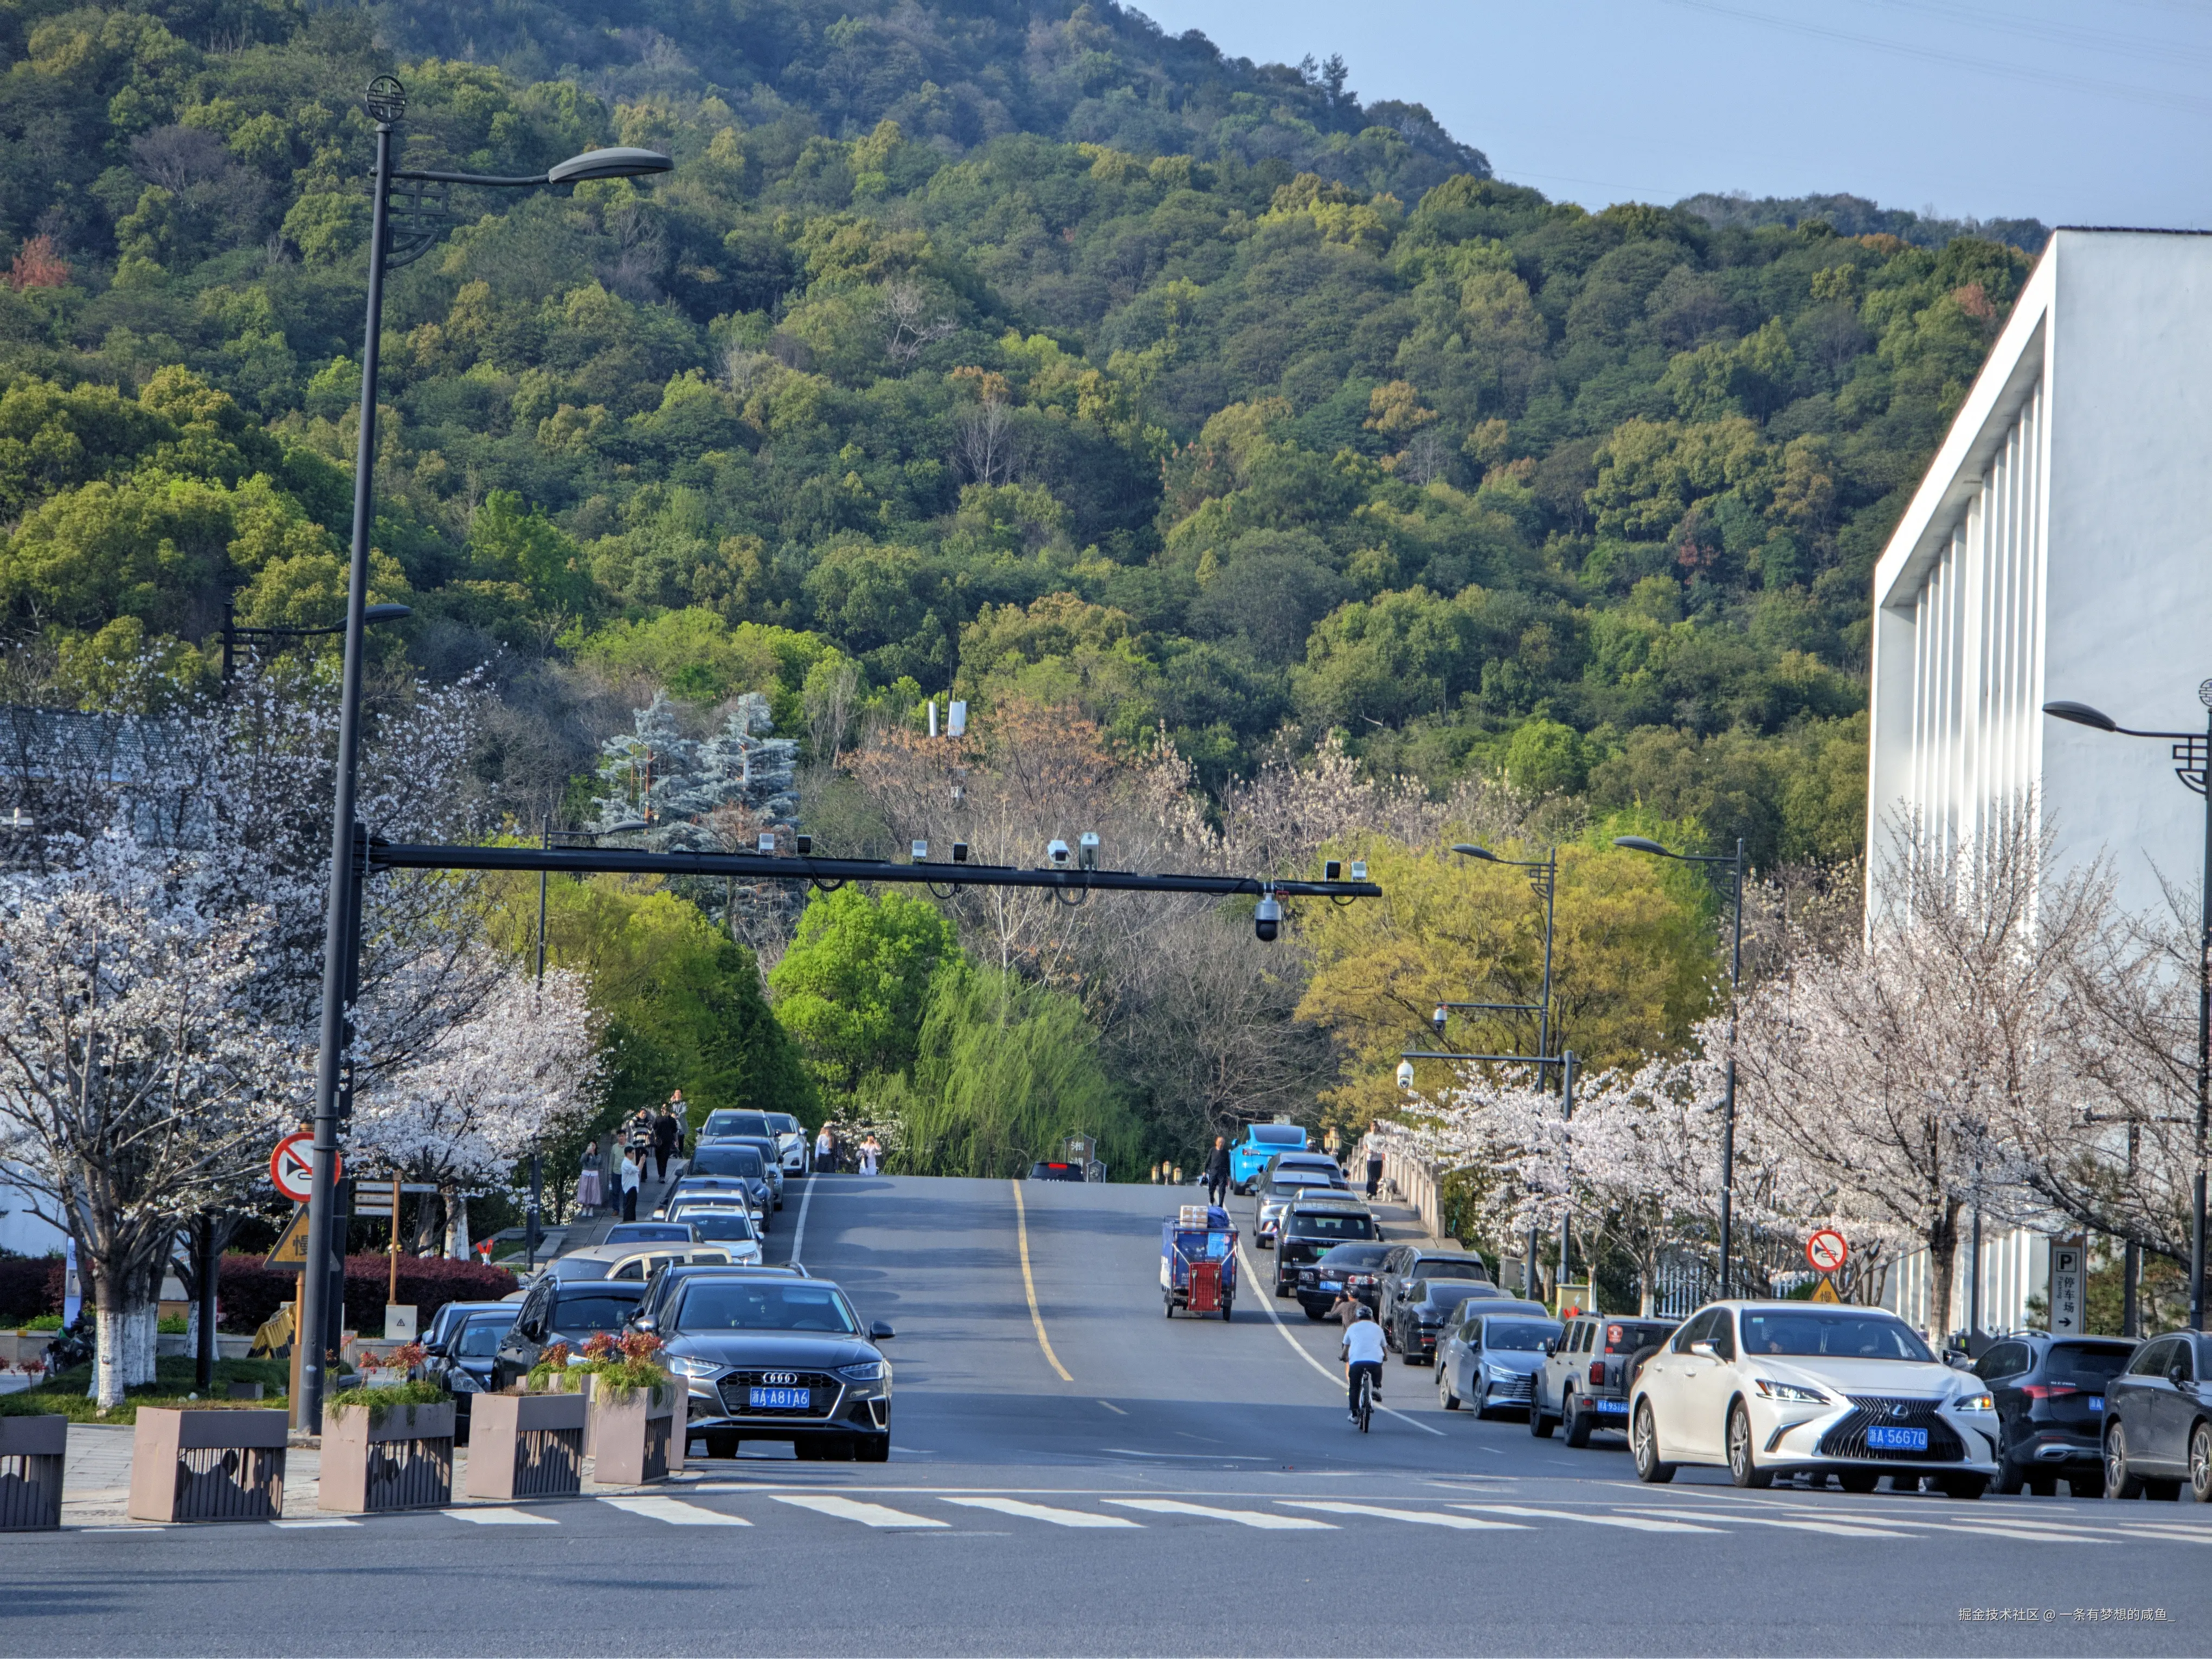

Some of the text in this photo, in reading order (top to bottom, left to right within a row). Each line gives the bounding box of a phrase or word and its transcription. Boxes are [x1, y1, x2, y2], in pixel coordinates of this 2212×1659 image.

[293, 1234, 308, 1256] 慢
[2060, 1253, 2073, 1270] P
[1819, 1291, 1832, 1303] 慢
[2063, 1276, 2075, 1314] 停车场
